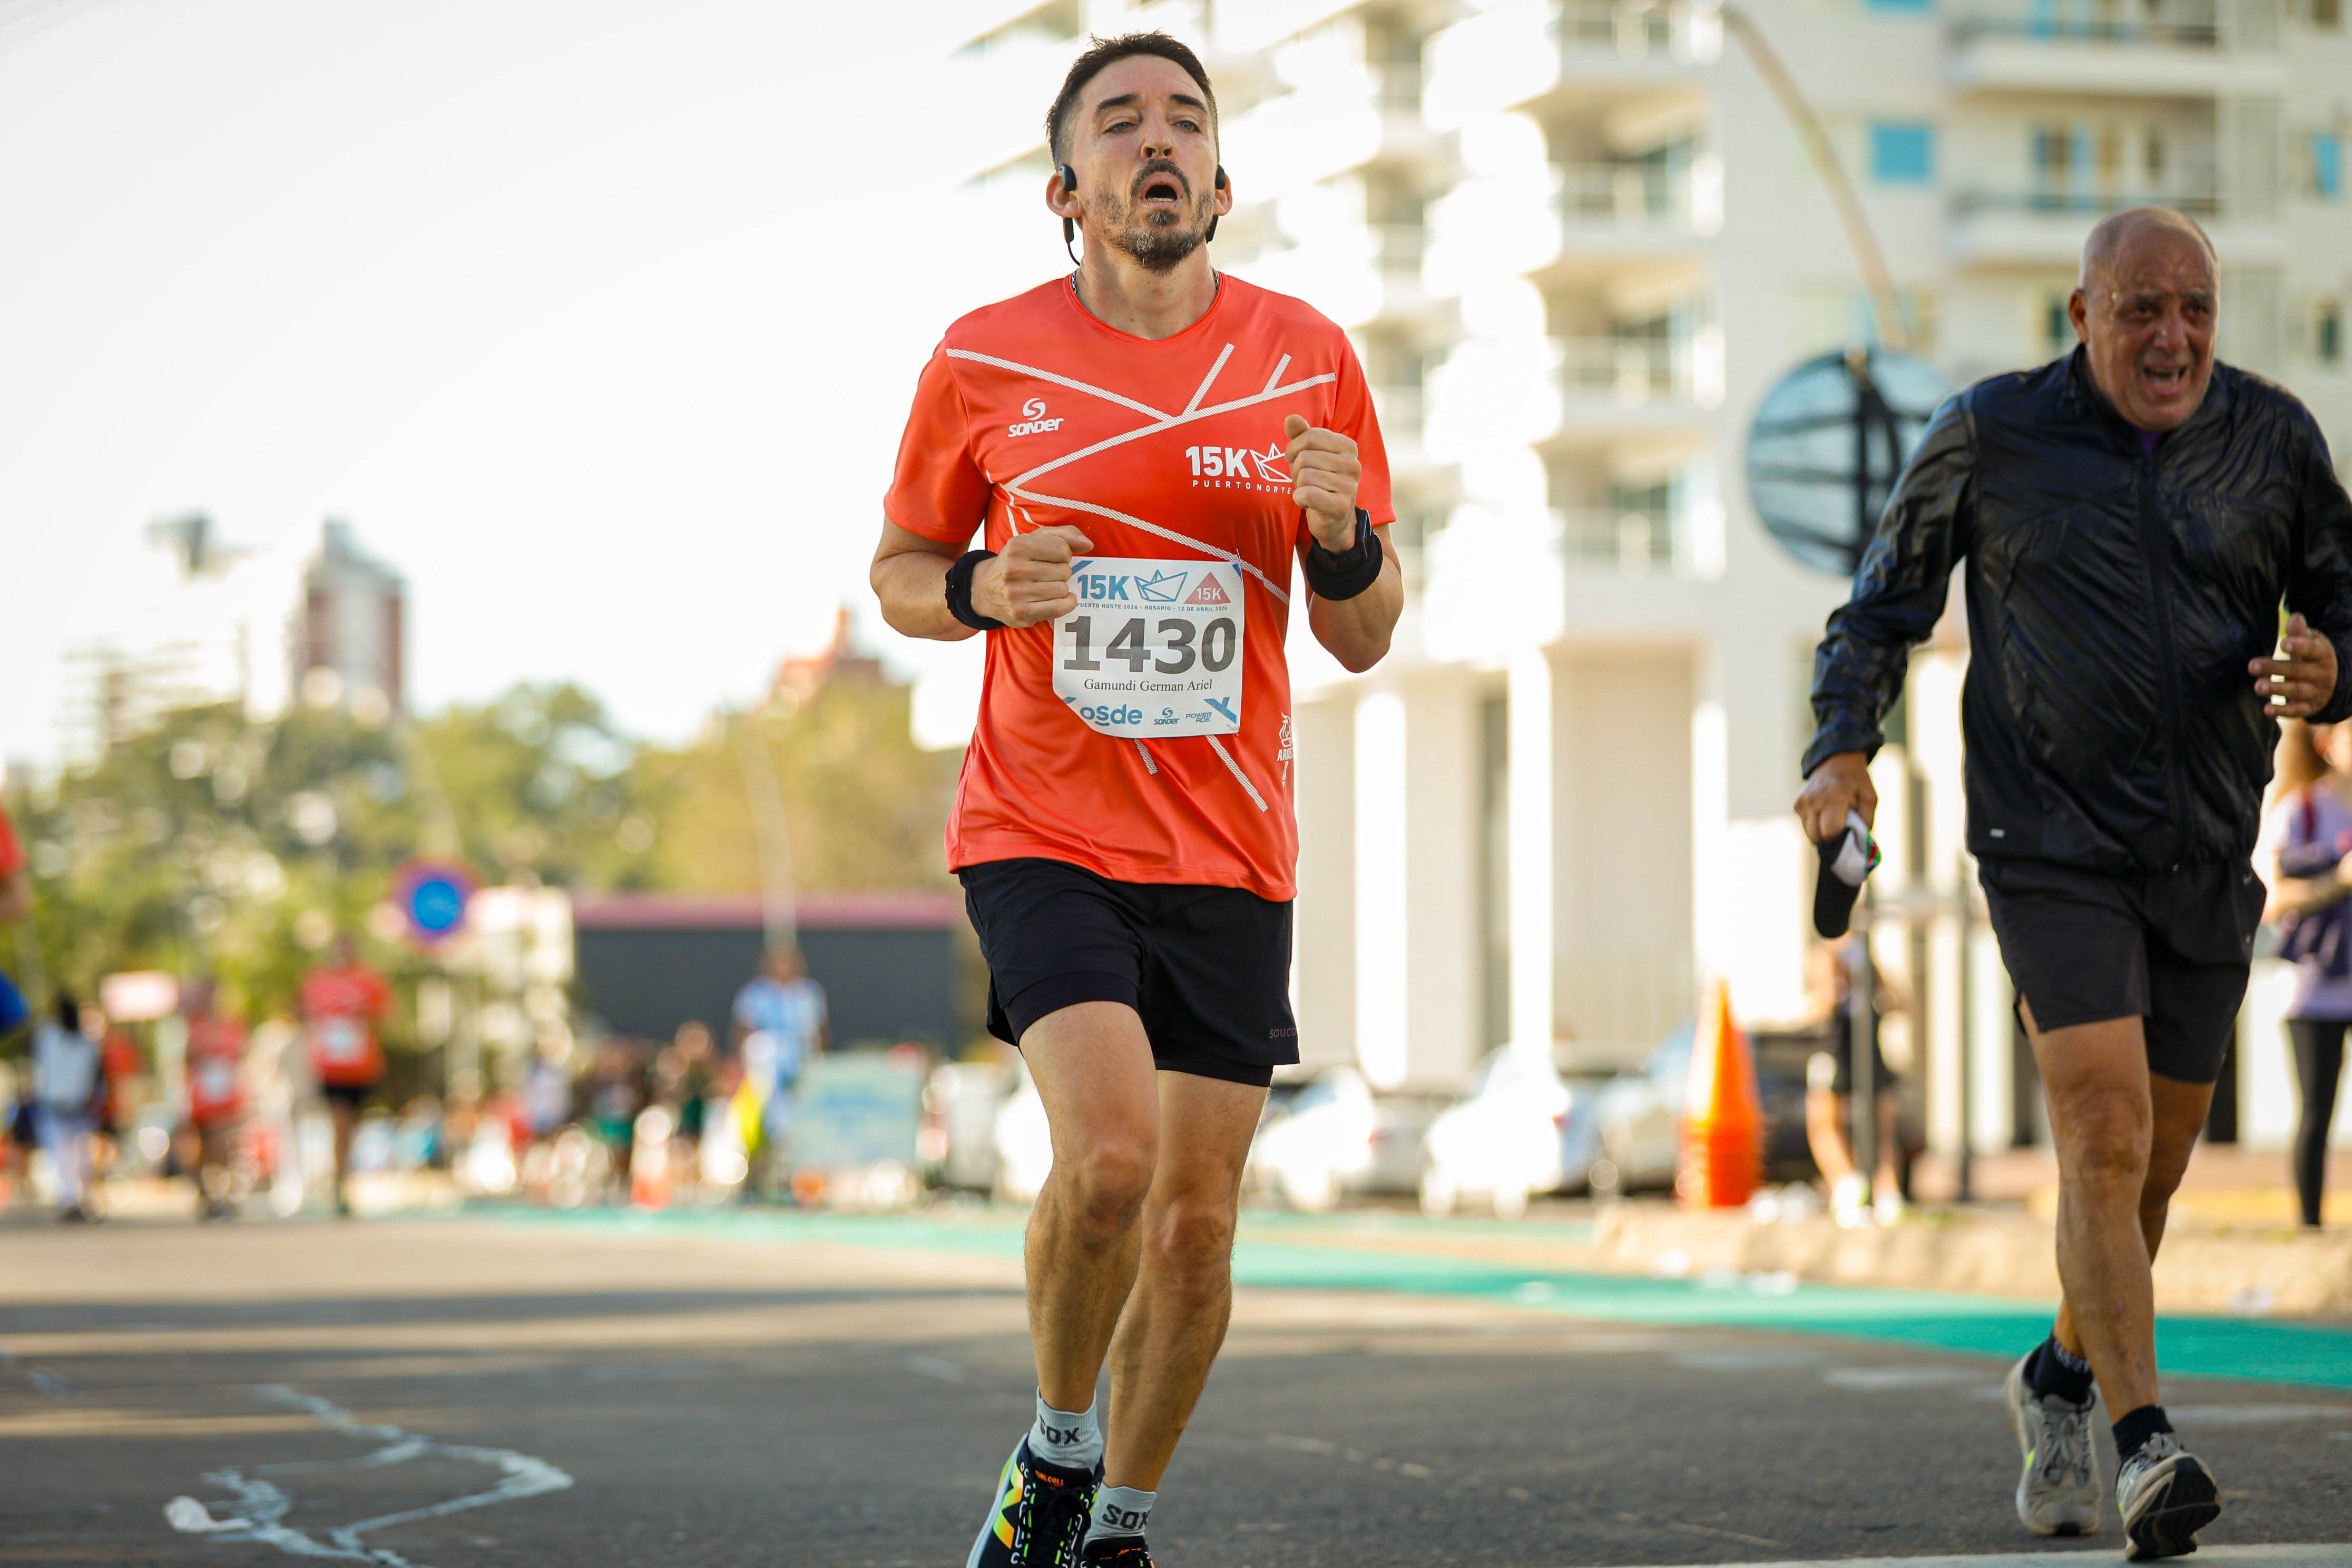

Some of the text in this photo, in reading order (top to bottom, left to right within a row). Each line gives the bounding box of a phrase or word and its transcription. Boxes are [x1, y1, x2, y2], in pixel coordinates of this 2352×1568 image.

[1185, 446, 1250, 478] 15K
[1192, 480, 1251, 489] PUERTO
[1077, 574, 1130, 600] 15K
[1197, 587, 1222, 600] 15K
[1064, 615, 1236, 674] 1430
[1084, 679, 1212, 691] Gamundi German Ariel
[1080, 704, 1142, 726] osde
[1102, 1504, 1151, 1529] SOX
